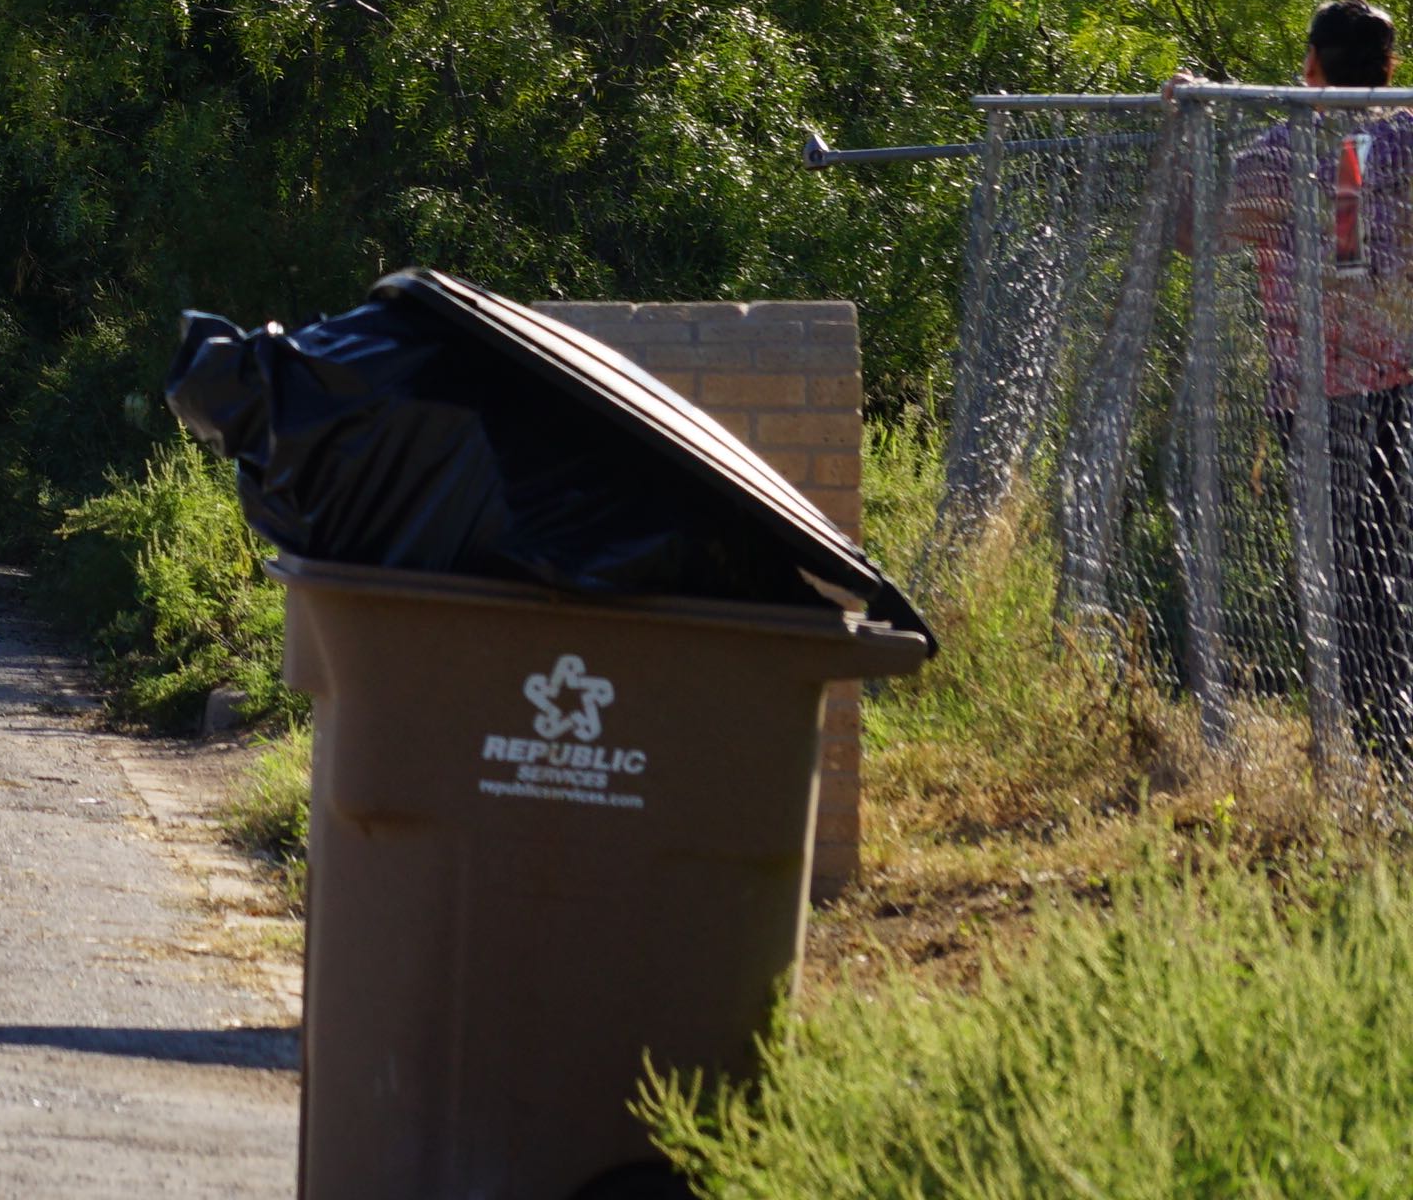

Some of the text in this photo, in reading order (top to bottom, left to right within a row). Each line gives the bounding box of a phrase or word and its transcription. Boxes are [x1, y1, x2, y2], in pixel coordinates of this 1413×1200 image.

[482, 734, 647, 775] REPUBLIC
[516, 763, 609, 789] SERVICES
[478, 777, 645, 809] republicservices.com
